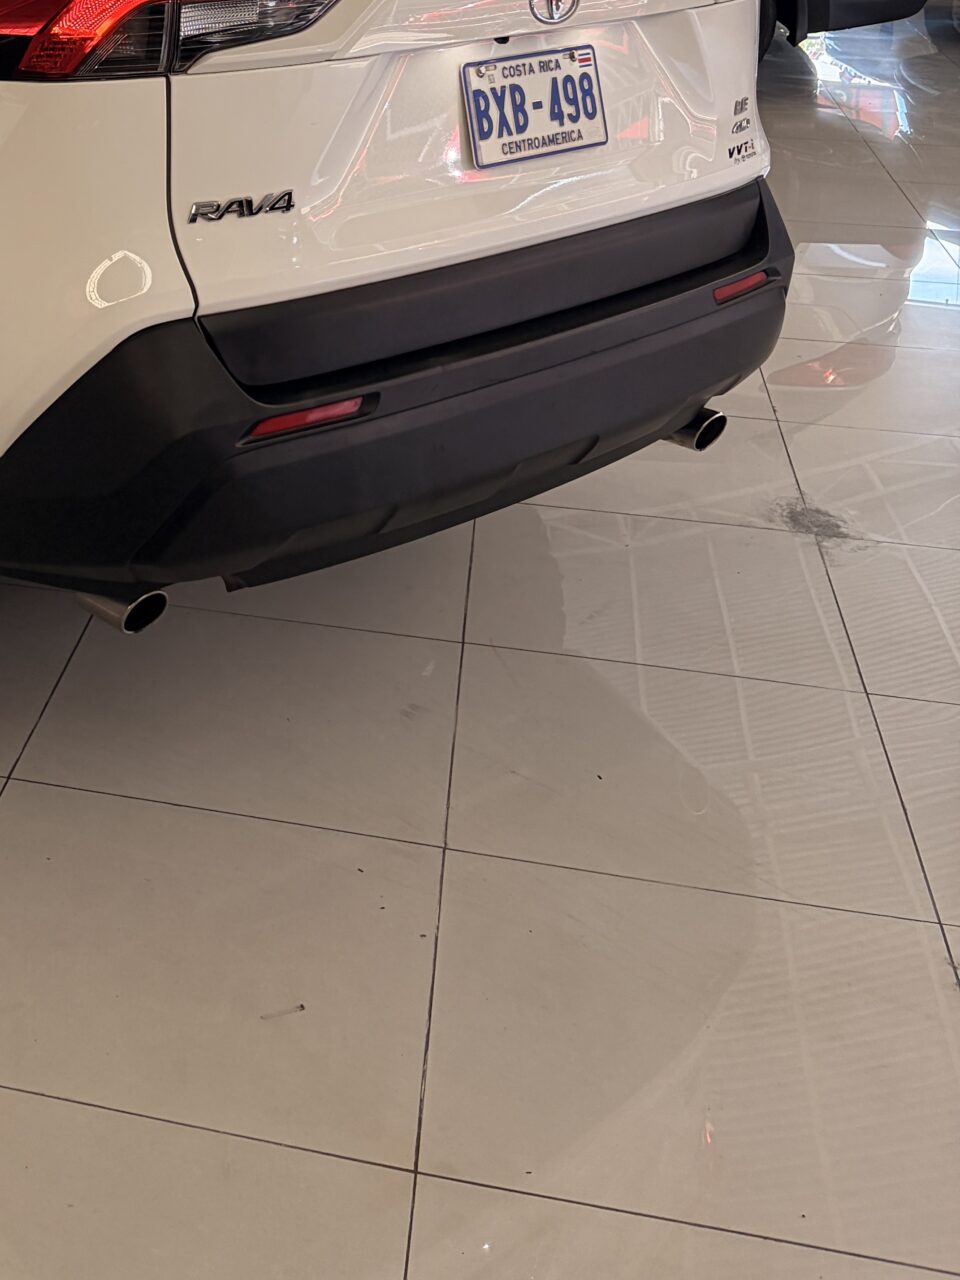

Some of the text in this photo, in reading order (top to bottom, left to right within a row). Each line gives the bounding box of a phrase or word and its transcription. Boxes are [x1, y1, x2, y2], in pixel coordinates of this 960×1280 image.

[501, 63, 535, 79] COSTA
[539, 58, 562, 73] RICA
[472, 71, 598, 140] BXB-498
[501, 128, 584, 155] CENTROAMERICA
[187, 188, 296, 225] RAV4
